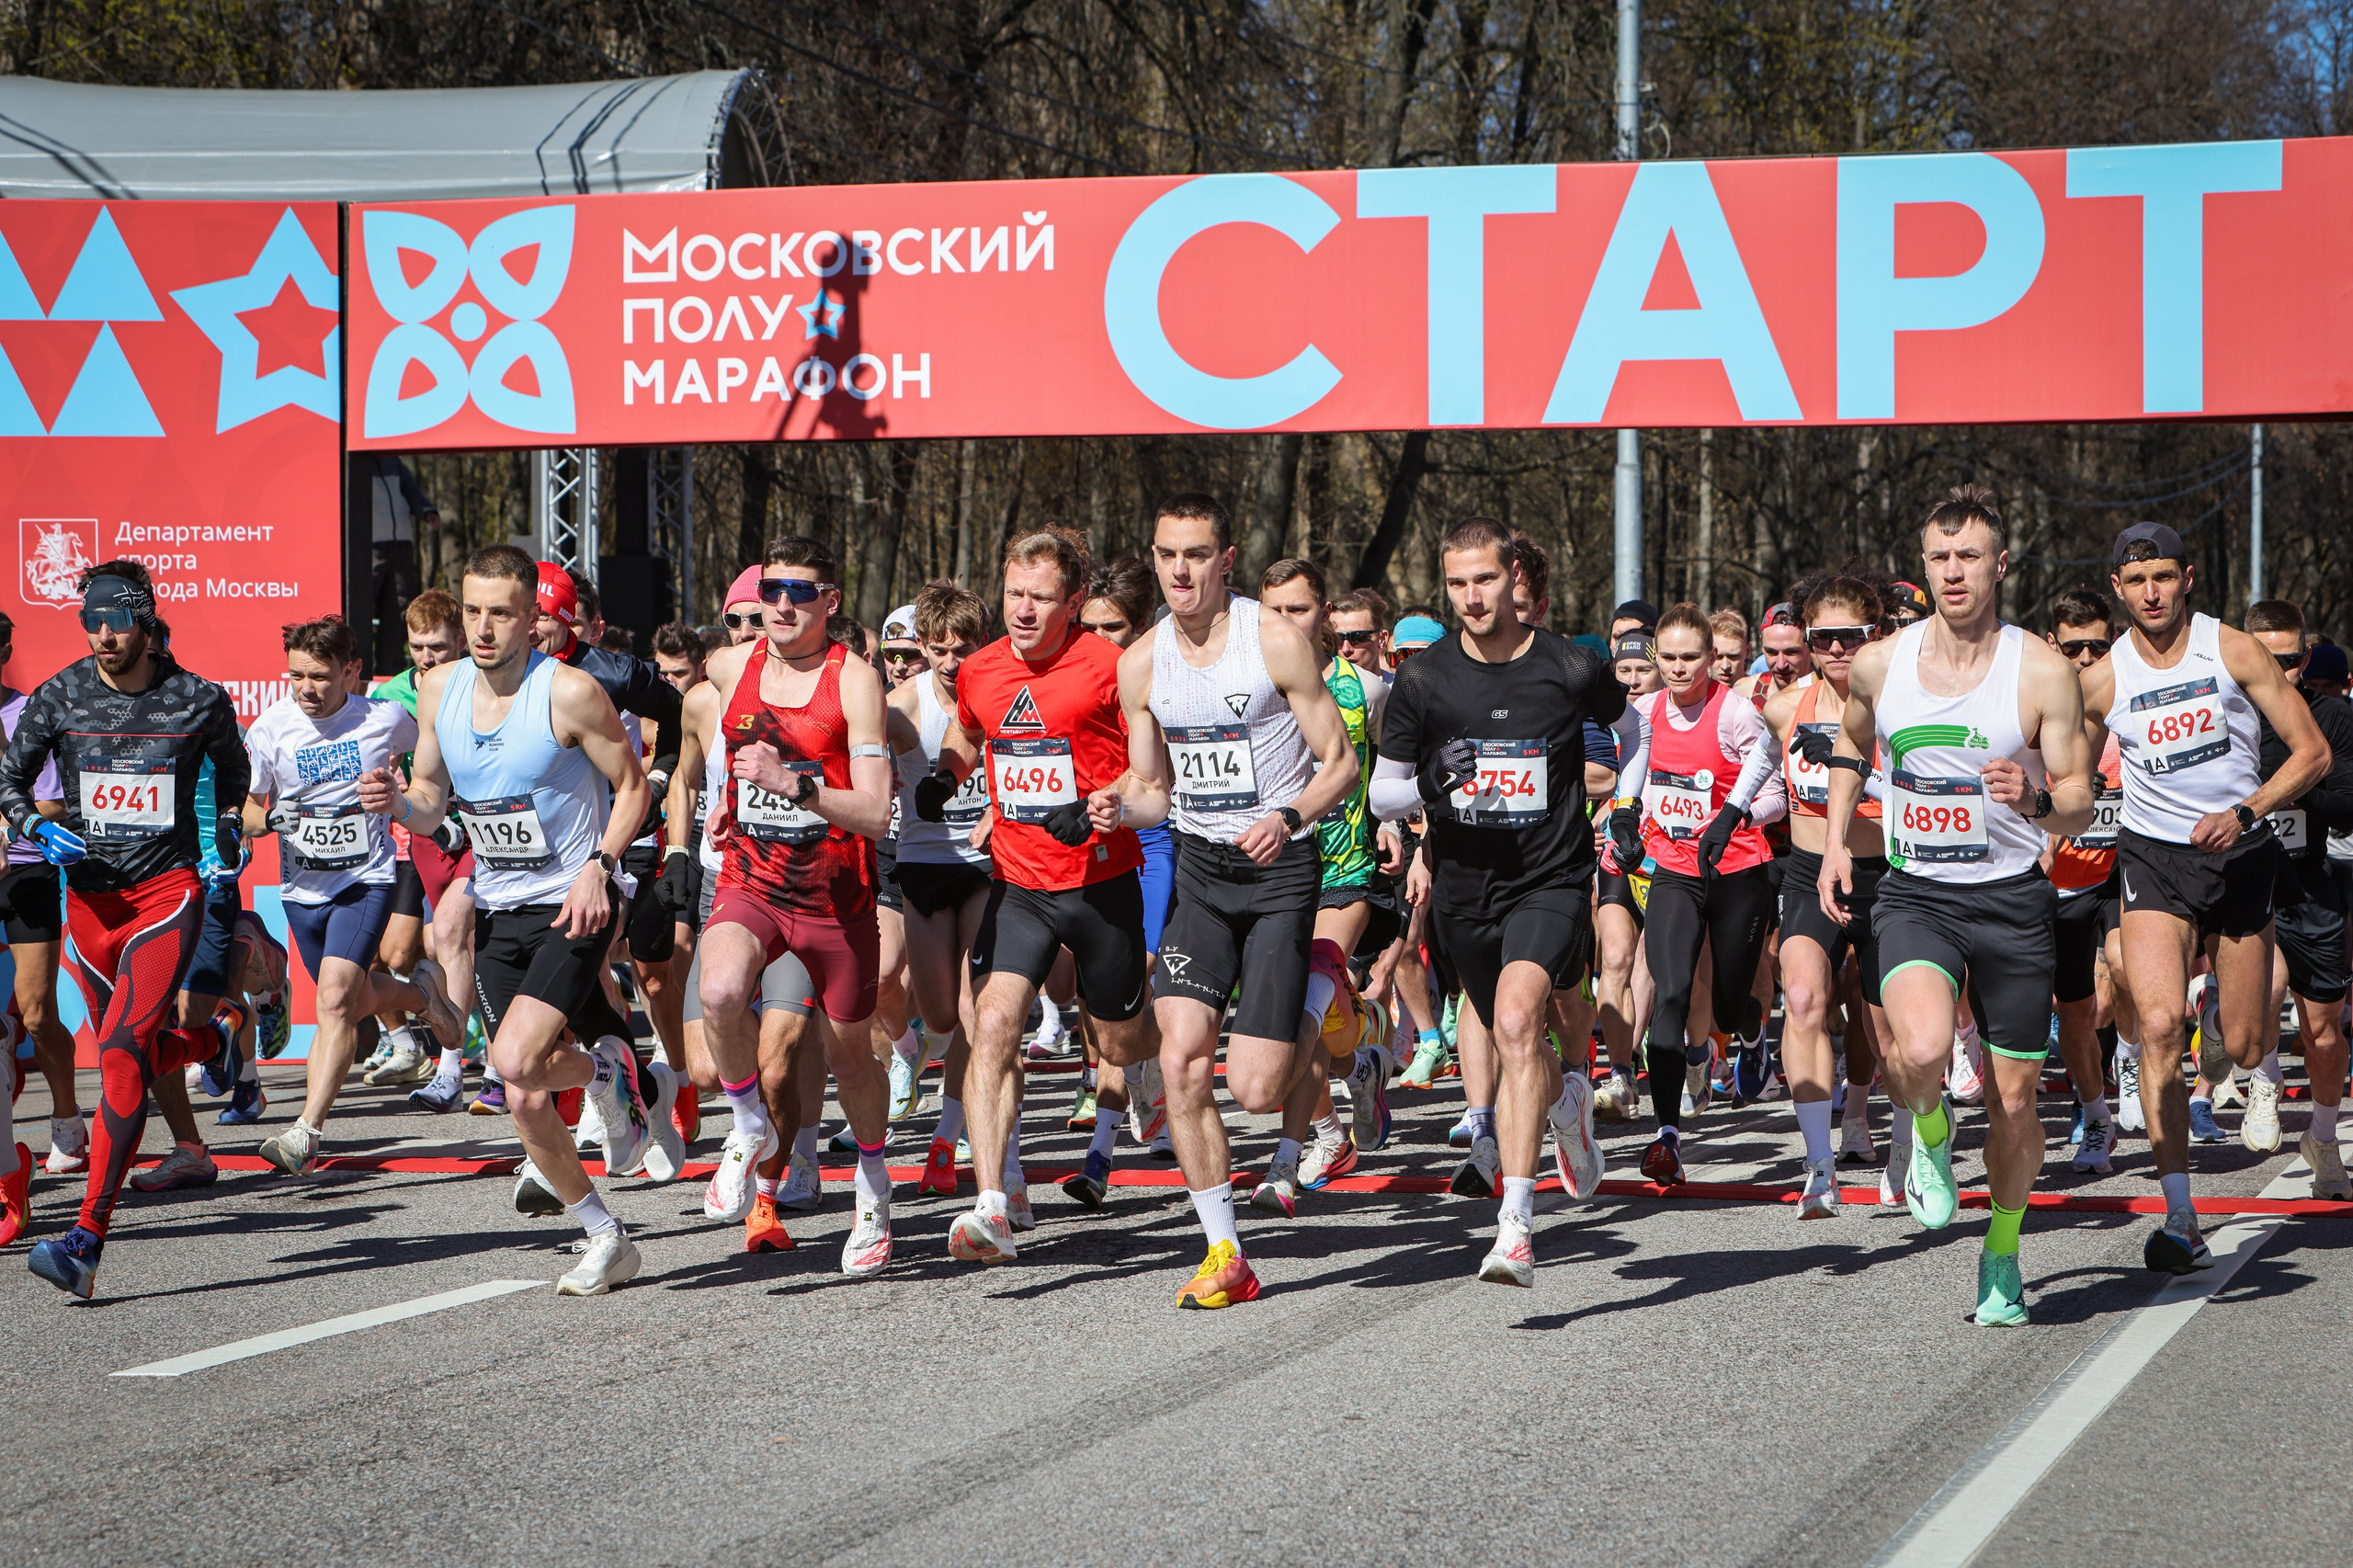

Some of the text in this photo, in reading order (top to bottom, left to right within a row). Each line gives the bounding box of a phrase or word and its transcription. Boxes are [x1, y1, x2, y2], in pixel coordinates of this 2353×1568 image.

[1104, 138, 2282, 430] СТАРТ
[623, 294, 794, 344] ПОЛУ
[623, 352, 930, 405] МАРАФОН
[115, 521, 274, 547] Департамент
[206, 578, 298, 597] Москвы
[2147, 708, 2216, 745] 6892
[1180, 750, 1241, 778] 2114
[2155, 756, 2165, 770] А
[1004, 767, 1063, 793] 6496
[1192, 778, 1230, 790] ДМИТРИЙ
[92, 784, 158, 812] 6941
[958, 797, 982, 806] АНТОН
[1660, 795, 1704, 821] 6493
[92, 821, 103, 835] А
[762, 812, 799, 822] ДАНИИЛ
[1462, 810, 1474, 823] А
[1903, 802, 1972, 834] 6898
[301, 822, 357, 846] 4525
[471, 821, 532, 845] 1196
[747, 824, 758, 837] А
[485, 846, 529, 854] АЛЕКСАНДР
[1903, 840, 1913, 856] А
[474, 972, 497, 1023] ADIXION
[1171, 977, 1226, 999] INSANITY
